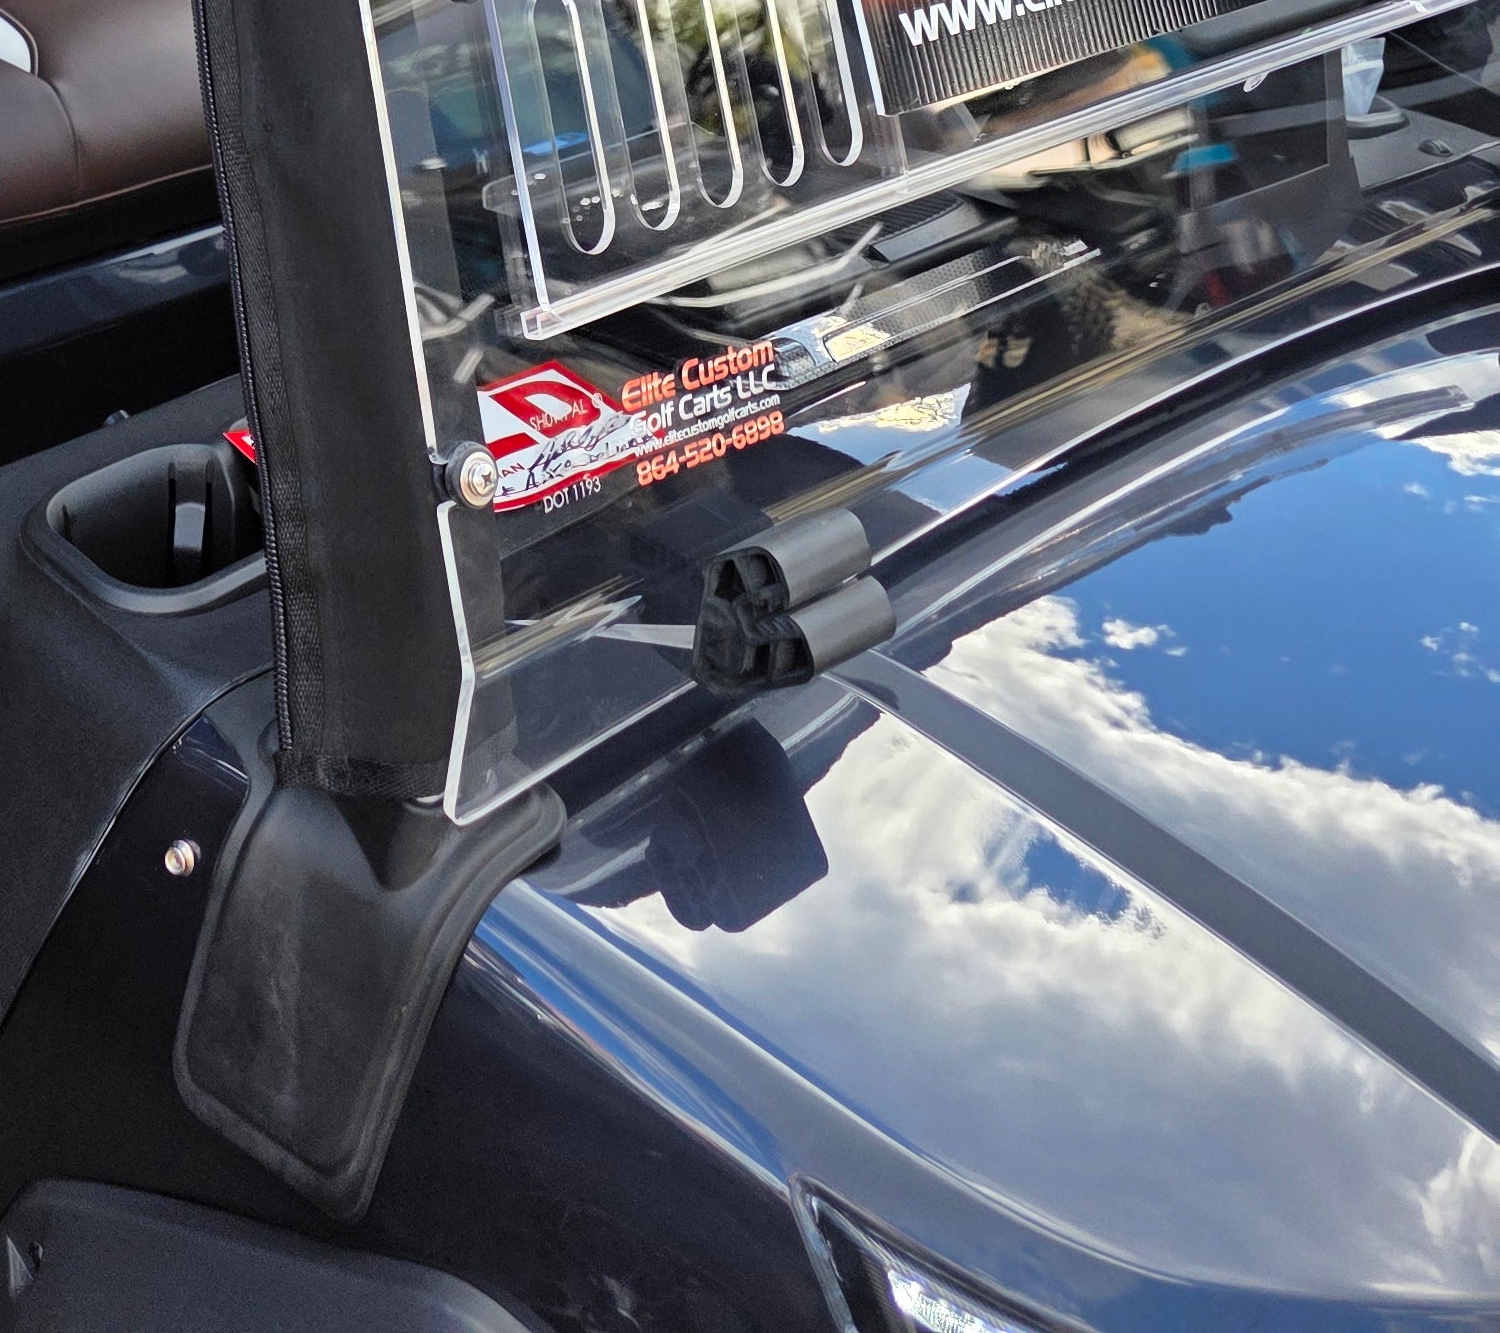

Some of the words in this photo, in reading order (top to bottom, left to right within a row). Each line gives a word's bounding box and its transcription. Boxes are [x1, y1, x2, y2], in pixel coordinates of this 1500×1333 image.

[621, 371, 676, 412] Elite
[681, 340, 775, 390] Custom
[629, 396, 675, 438] Golf
[678, 385, 731, 422] Carts
[737, 364, 778, 400] LLC
[633, 393, 780, 459] www.elitecustomgolfcarts.com
[636, 410, 785, 487] 864-520-6898
[543, 488, 570, 514] DOT
[573, 474, 602, 501] 1193
